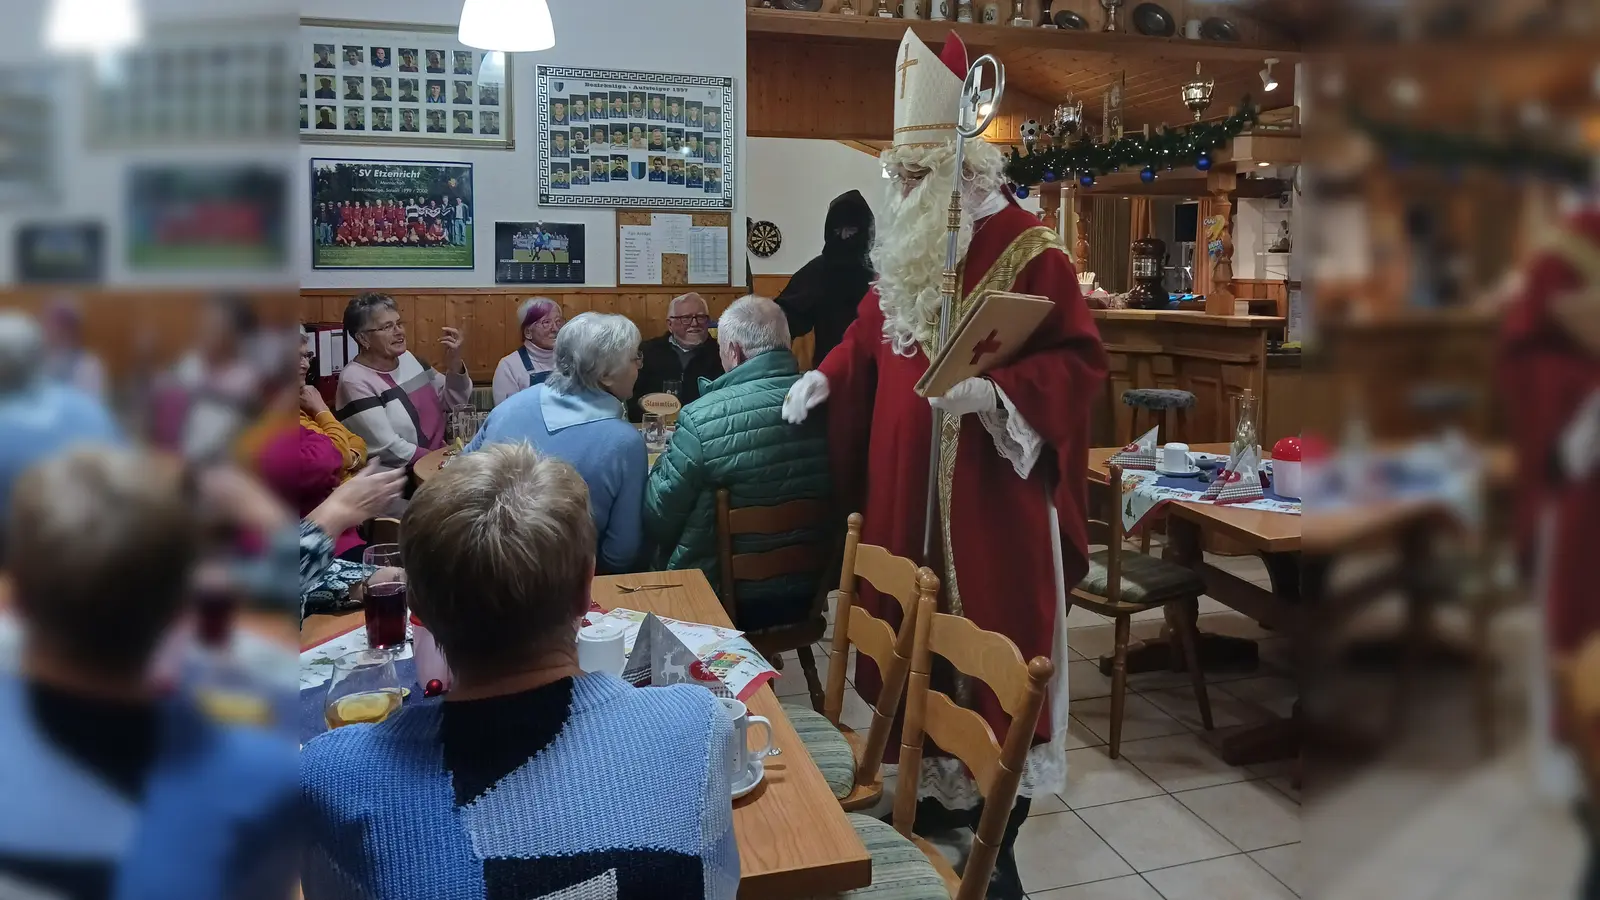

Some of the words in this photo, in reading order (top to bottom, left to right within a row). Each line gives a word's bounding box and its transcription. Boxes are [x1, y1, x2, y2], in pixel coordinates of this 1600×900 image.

[358, 169, 371, 177] SV
[374, 169, 421, 178] Etzenricht
[644, 400, 678, 409] Stammtisch
